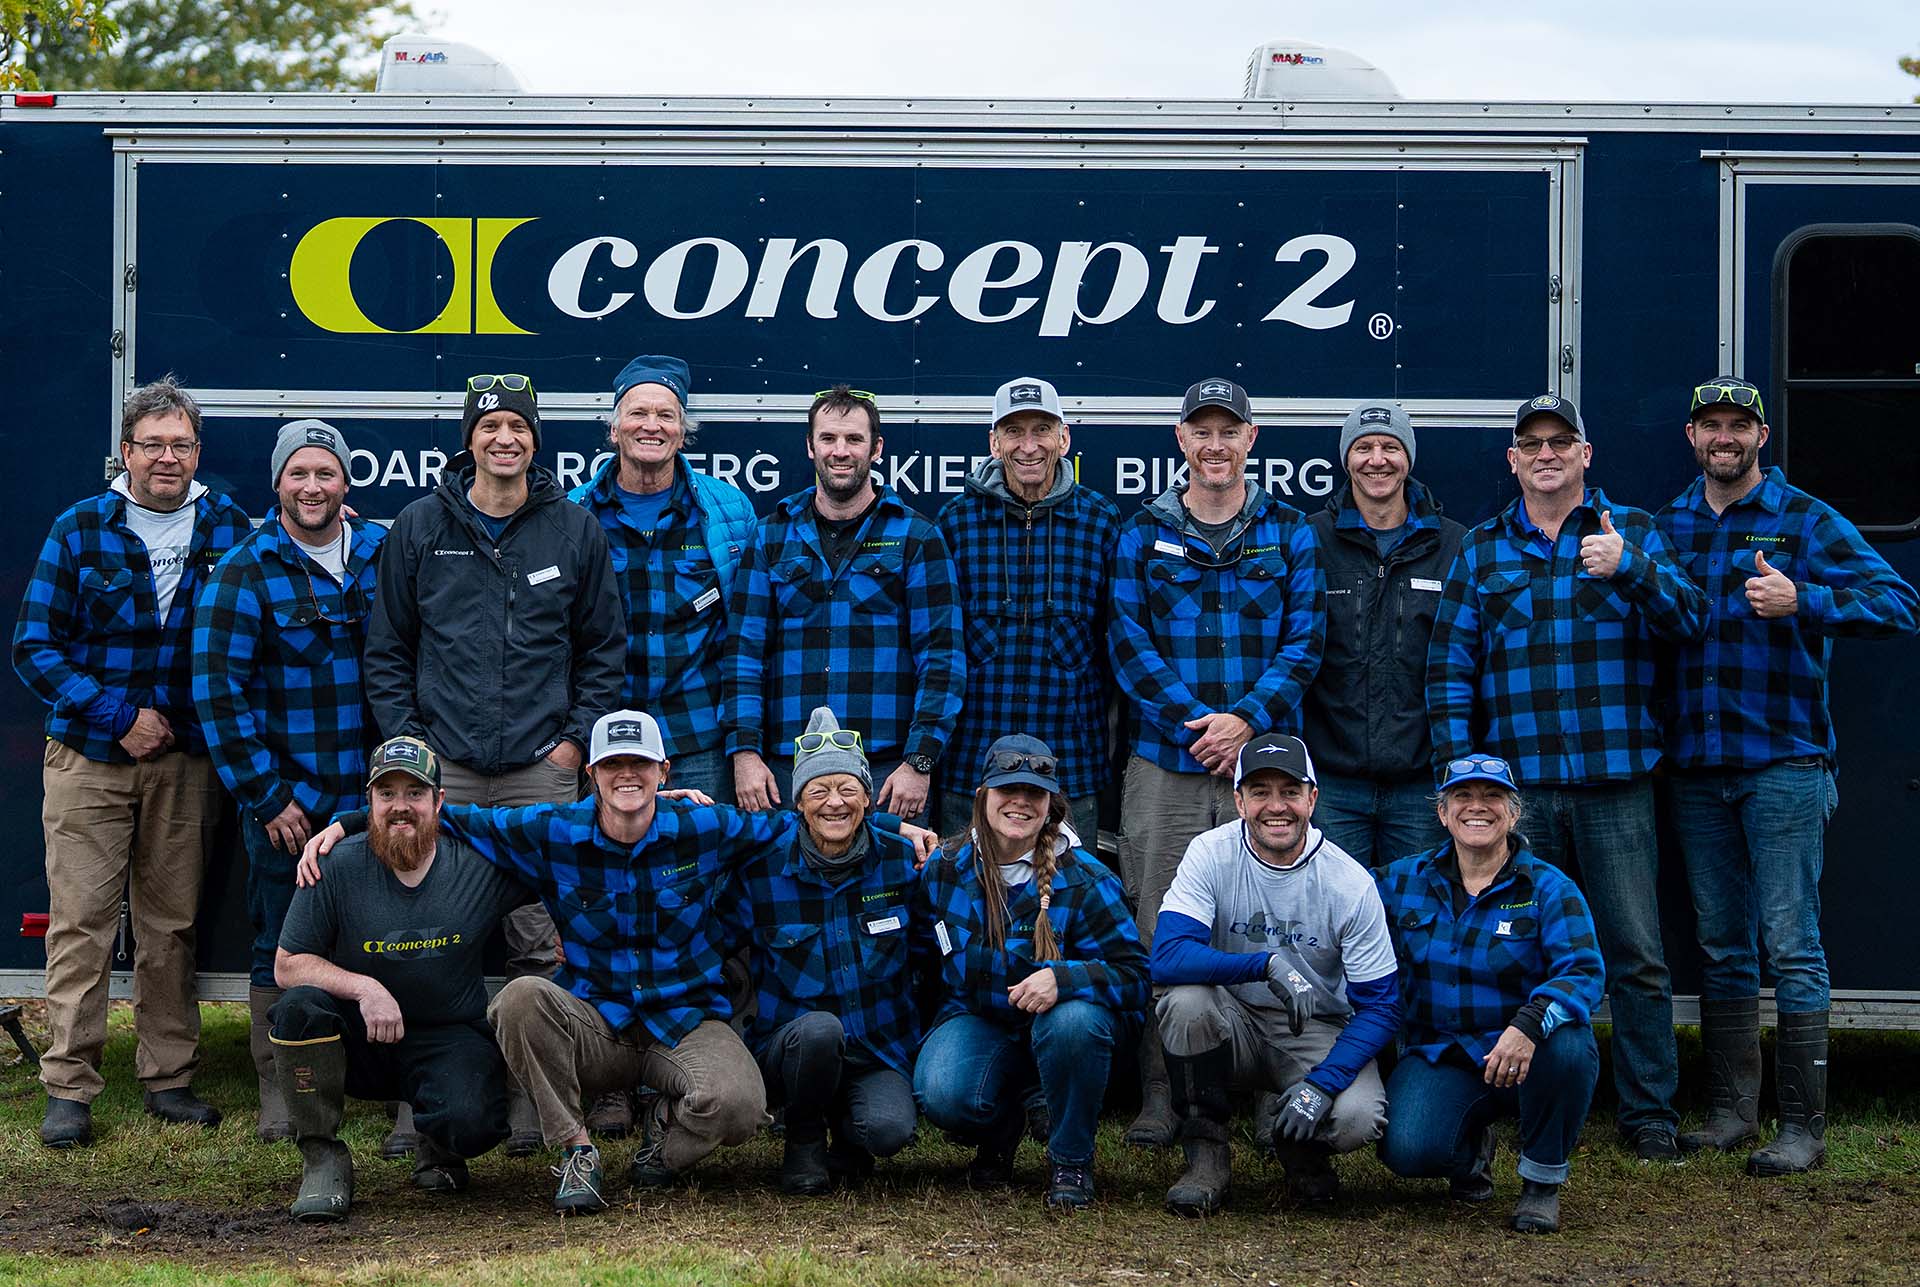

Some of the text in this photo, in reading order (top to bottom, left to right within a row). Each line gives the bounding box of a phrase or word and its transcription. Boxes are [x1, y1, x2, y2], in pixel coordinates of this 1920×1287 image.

[547, 234, 1221, 337] concept
[1260, 233, 1357, 330] 2
[350, 449, 467, 488] OAR
[1116, 457, 1333, 497] BIKRG
[386, 936, 449, 952] concept
